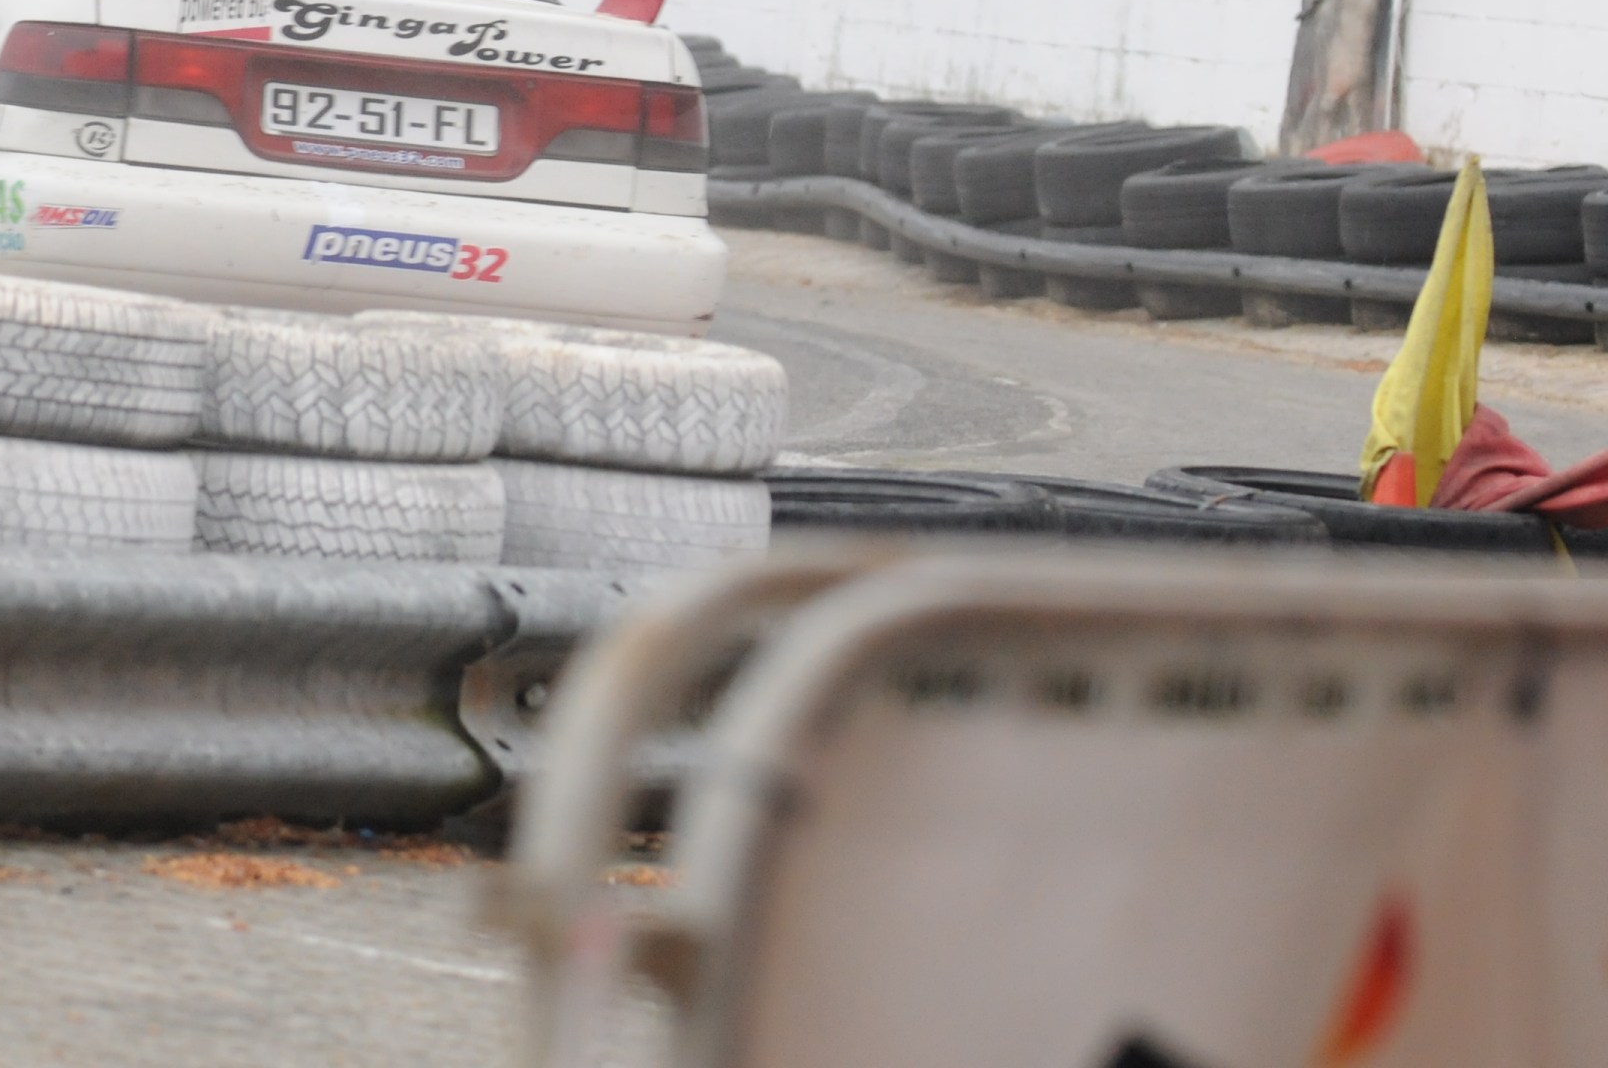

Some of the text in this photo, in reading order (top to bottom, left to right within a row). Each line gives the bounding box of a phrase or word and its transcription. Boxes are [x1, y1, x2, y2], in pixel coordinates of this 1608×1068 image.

[448, 19, 605, 72] Power
[270, 87, 489, 148] 92-51-FL
[27, 205, 118, 227] AMSOIL
